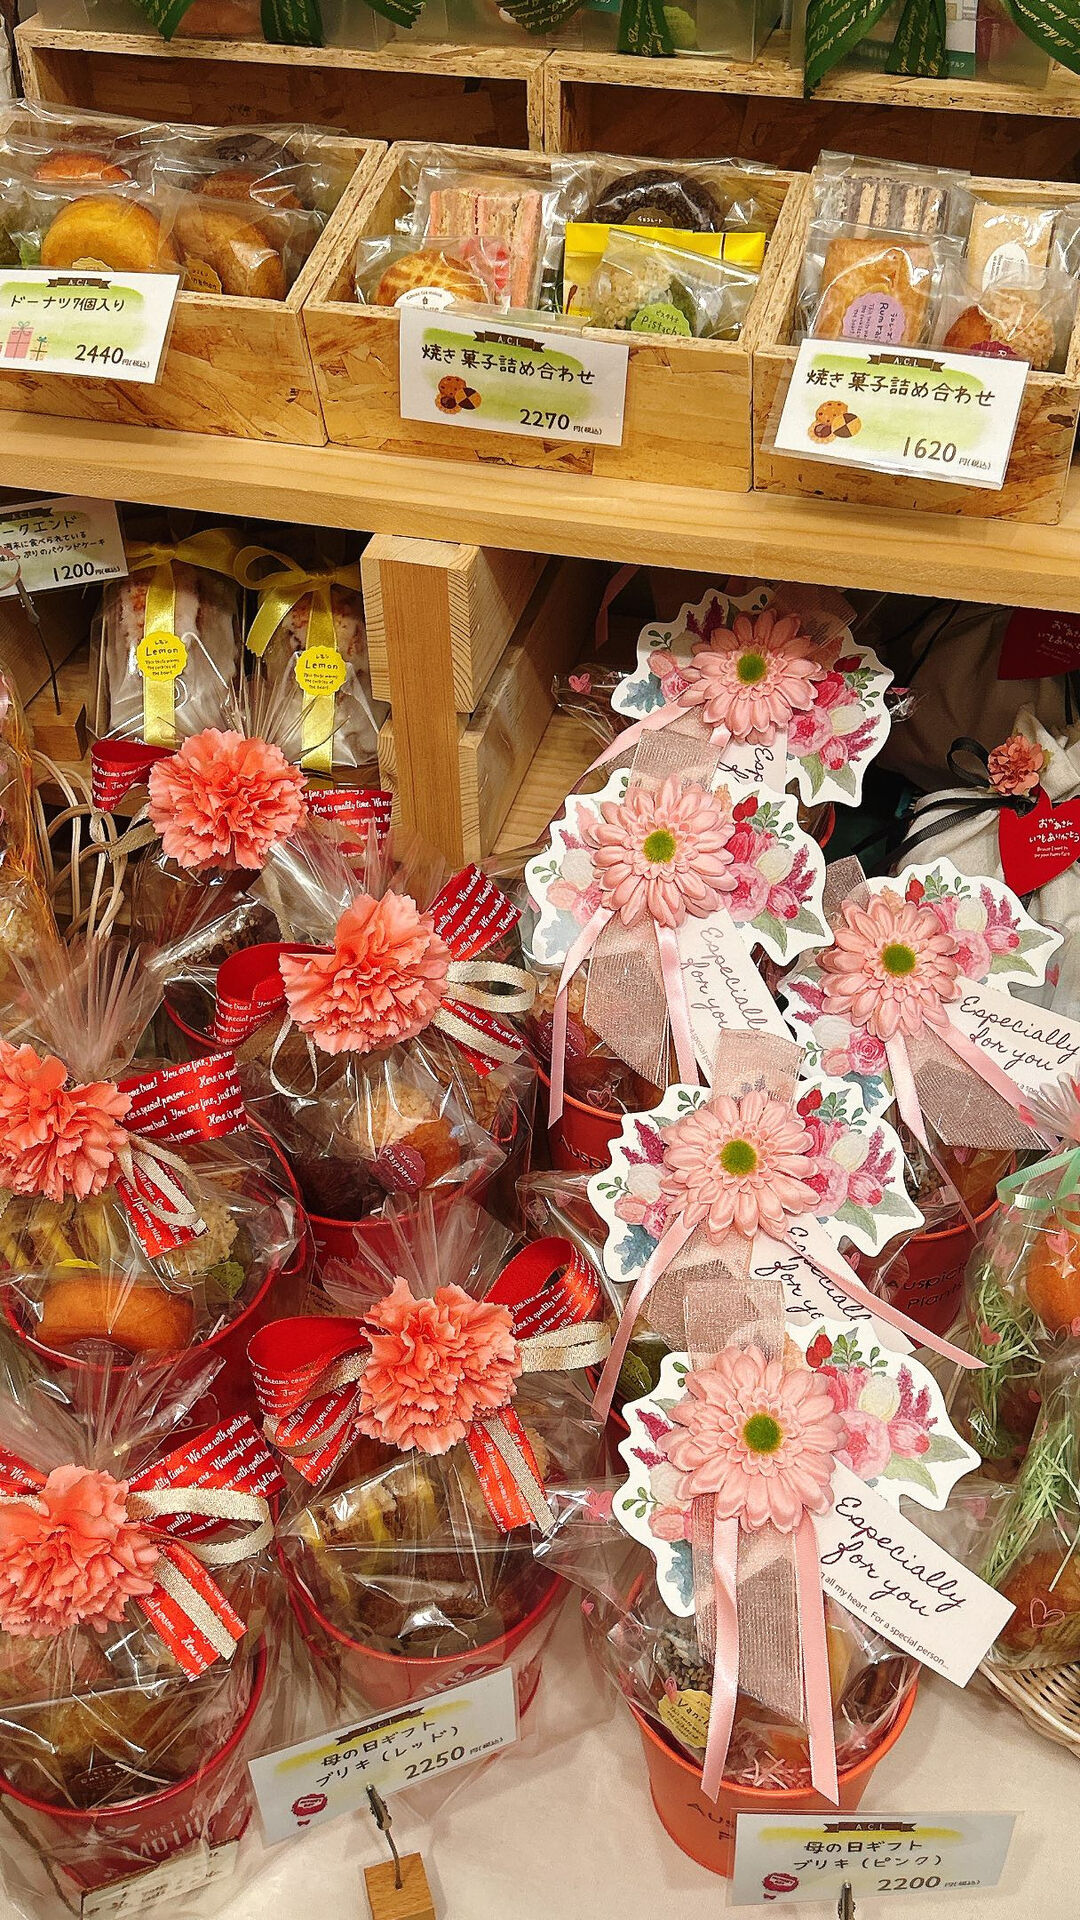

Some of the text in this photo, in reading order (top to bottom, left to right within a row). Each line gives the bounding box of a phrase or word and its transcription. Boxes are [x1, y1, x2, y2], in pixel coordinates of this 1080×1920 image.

[11, 294, 125, 312] ドーナツ7個入り
[75, 344, 124, 364] 2440
[421, 344, 596, 385] 焼き菓子詰め合わせ
[806, 368, 996, 407] 焼き菓子詰め合わせ
[520, 408, 570, 430] 2270
[902, 436, 957, 463] 1620
[53, 562, 94, 582] 1200
[146, 646, 178, 656] Lemon
[306, 660, 338, 670] Lemon
[1029, 830, 1080, 844] いつもありがとう
[680, 958, 731, 1030] for you
[960, 996, 1080, 1064] Especially
[1003, 1050, 1053, 1071] you
[159, 1066, 178, 1082] You
[169, 1104, 188, 1120] You
[383, 1148, 417, 1186] Raspberry
[755, 1260, 803, 1296] for
[836, 1496, 967, 1613] Especially
[820, 1540, 930, 1617] for you
[825, 1576, 836, 1588] all
[836, 1583, 848, 1598] my
[870, 1611, 884, 1626] For
[890, 1626, 919, 1648] special
[321, 1720, 436, 1767] 母の日ギフト
[316, 1726, 459, 1787] ブリキ（レッド）
[404, 1746, 466, 1780] 2250
[804, 1840, 923, 1854] 母の日ギフト
[792, 1854, 942, 1872] ブリキ（ピンク）
[876, 1875, 941, 1892] 2200
